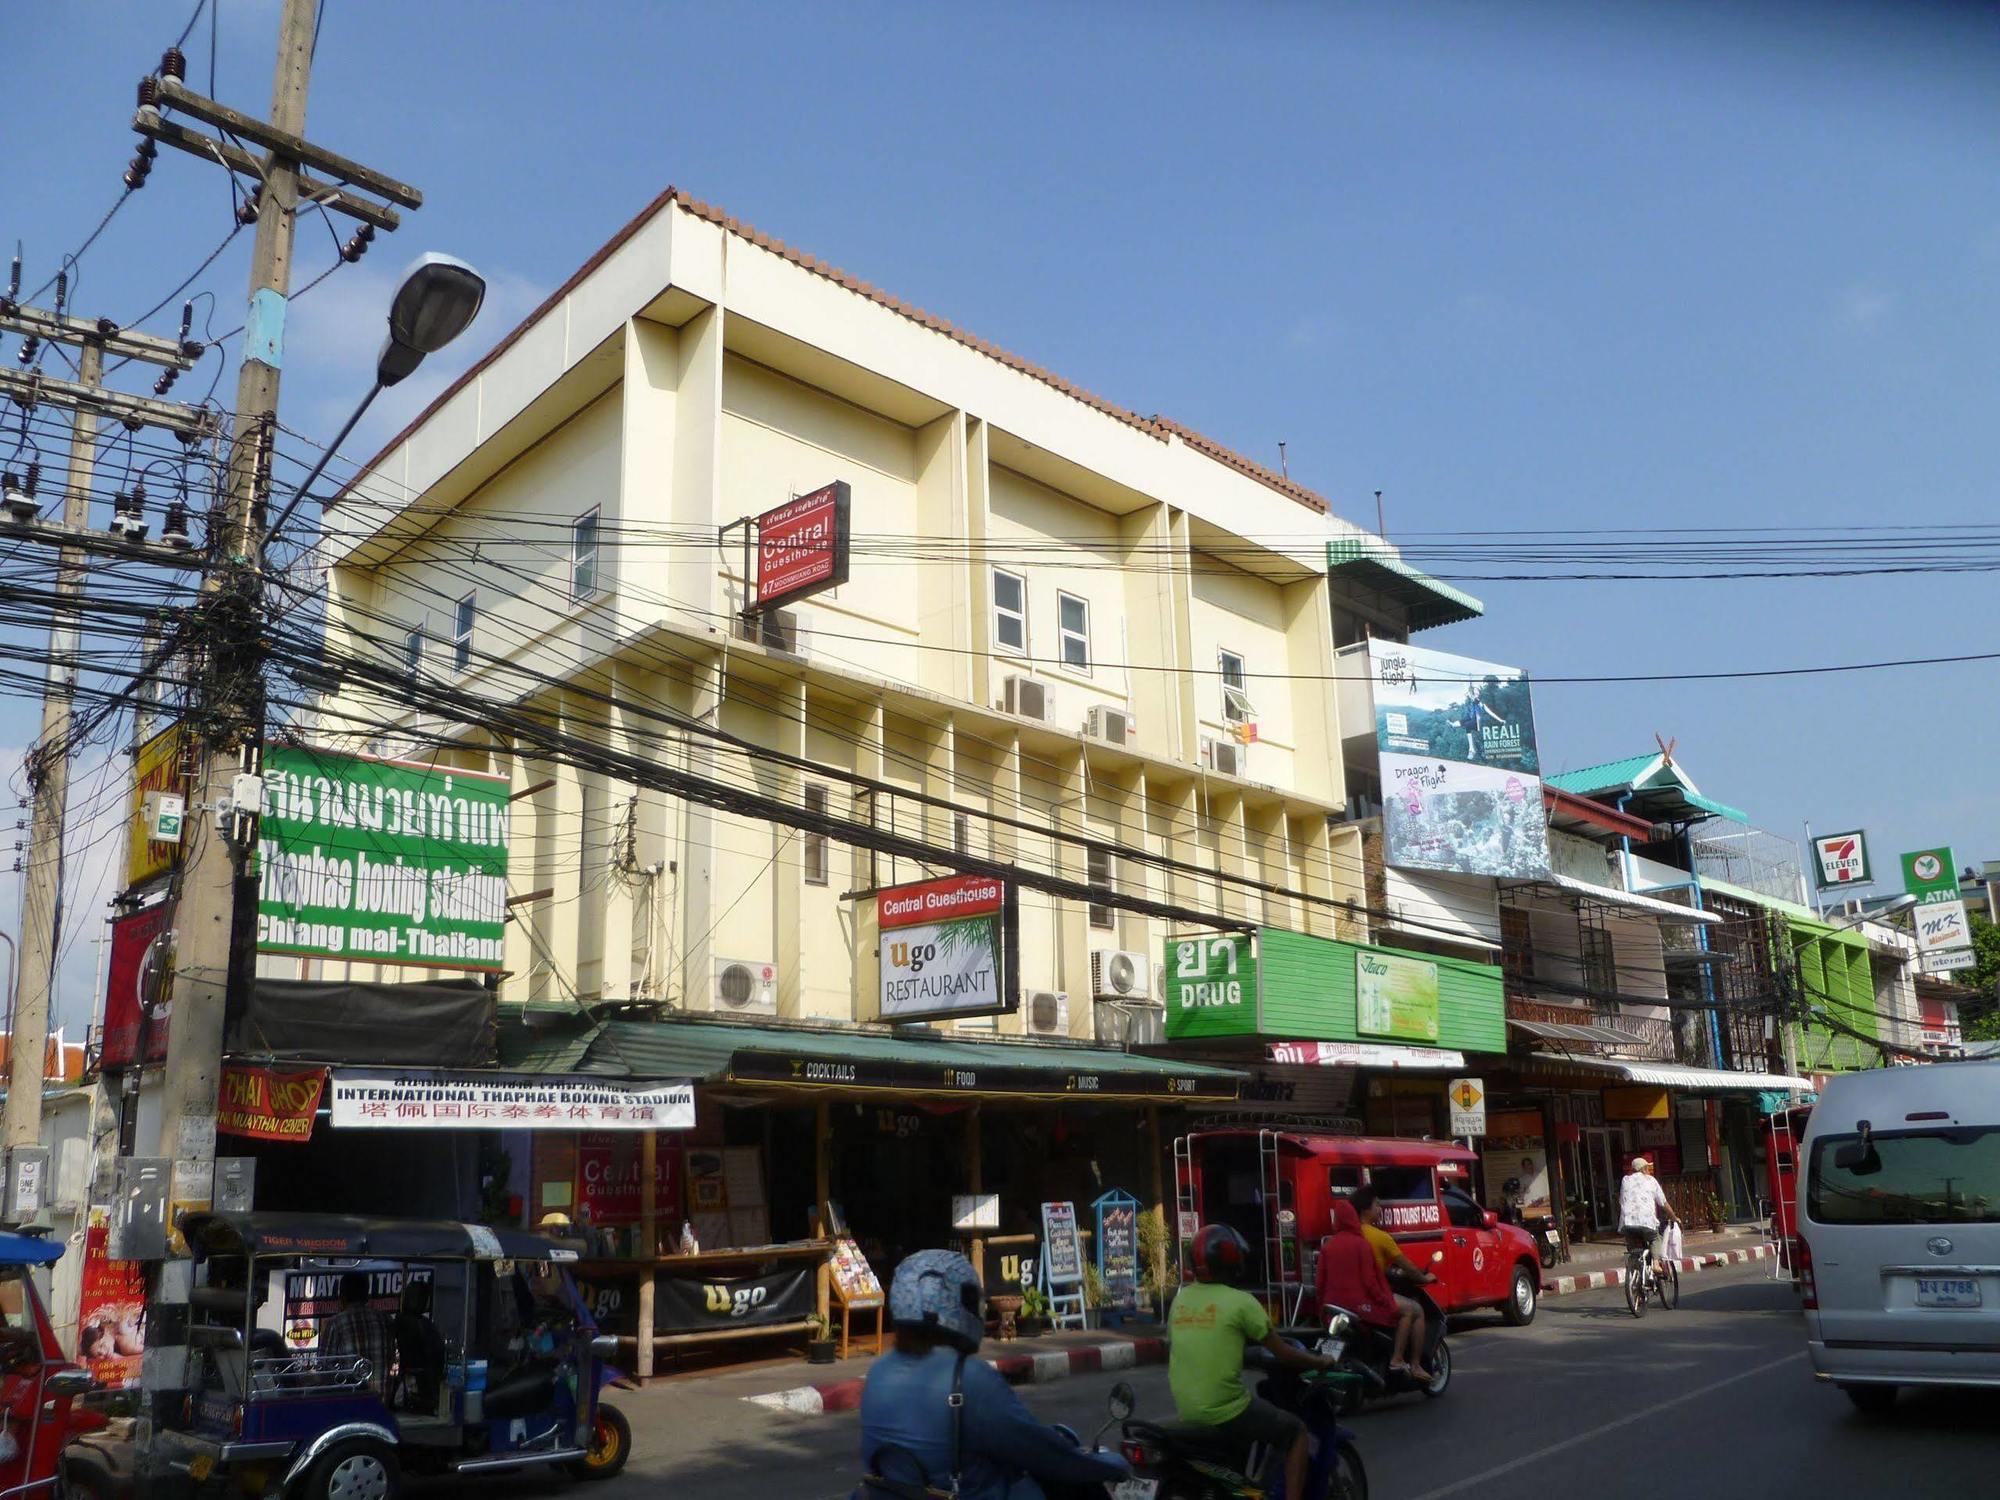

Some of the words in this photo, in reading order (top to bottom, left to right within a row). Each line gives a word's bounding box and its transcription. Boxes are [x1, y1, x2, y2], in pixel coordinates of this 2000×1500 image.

[763, 516, 828, 558] Central
[764, 540, 828, 572] Guesthouse
[761, 580, 775, 595] 47
[1482, 724, 1520, 740] REAL!
[1483, 740, 1498, 749] RAIN
[1499, 739, 1520, 748] FOREST
[1395, 765, 1429, 779] Dragon
[1420, 772, 1446, 789] Flight
[1824, 839, 1855, 880] 7
[258, 838, 352, 911] Thaphae
[355, 851, 428, 923] boxing
[884, 895, 923, 915] Central
[927, 886, 996, 908] Guesthouse
[1925, 889, 1956, 904] ATM
[257, 913, 344, 952] Chiang
[1922, 912, 1960, 935] MK
[891, 941, 936, 972] ugo
[1177, 939, 1237, 978] ยา
[886, 970, 990, 1002] RESTAURANT
[1181, 981, 1241, 1008] DRUG
[806, 1062, 855, 1080] COCKTAILS
[956, 1071, 976, 1085] FOOD
[226, 1072, 262, 1107] THAI
[1078, 1076, 1099, 1089] MUSIC
[1177, 1079, 1196, 1091] SPORT
[337, 1088, 477, 1102] INTERNATIONAL
[481, 1090, 556, 1104] THAPHAE
[561, 1092, 621, 1105] BOXING
[624, 1093, 691, 1105] STADIUM
[360, 1102, 655, 1120] 塔佩国际泰拳体育馆
[1393, 1207, 1401, 1225] TO
[1401, 1206, 1421, 1225] TOURIST
[1421, 1205, 1440, 1224] PLACES
[263, 1235, 292, 1246] TIGER
[703, 1284, 767, 1317] ugo
